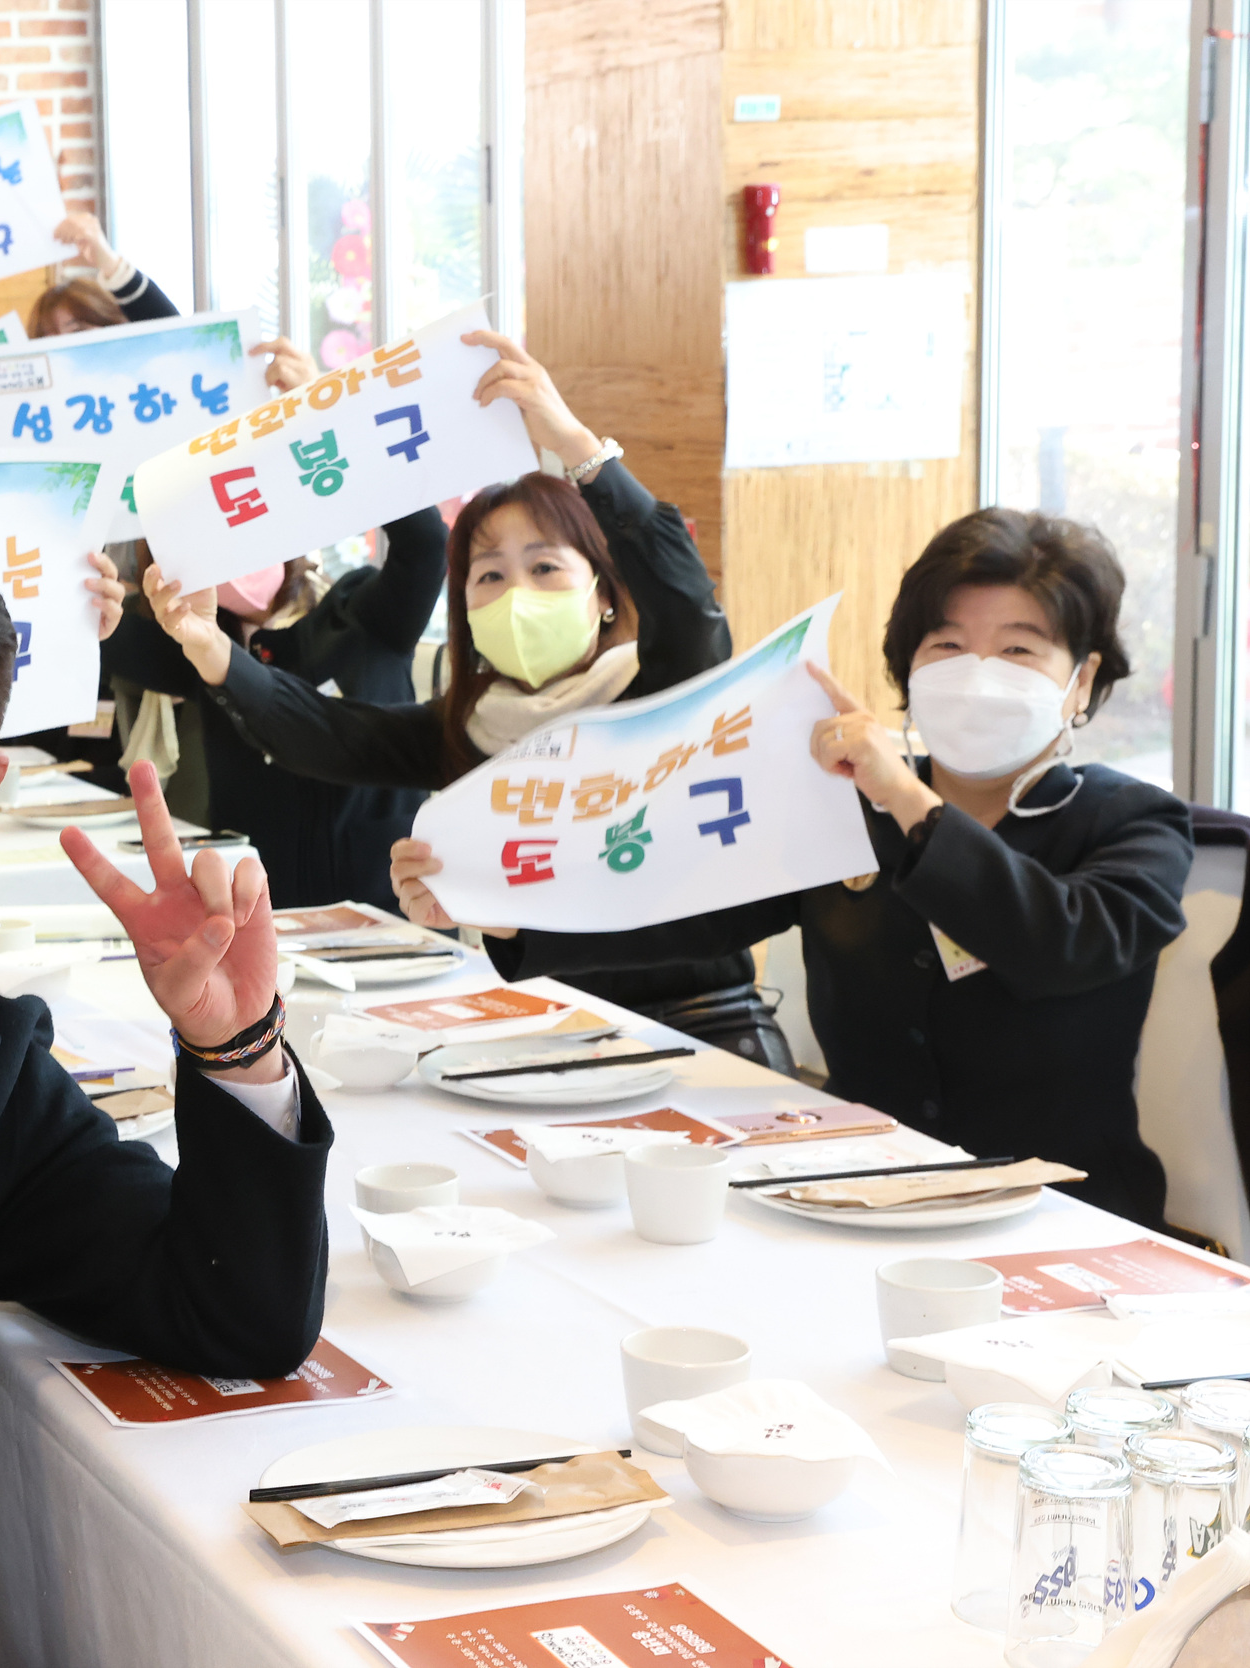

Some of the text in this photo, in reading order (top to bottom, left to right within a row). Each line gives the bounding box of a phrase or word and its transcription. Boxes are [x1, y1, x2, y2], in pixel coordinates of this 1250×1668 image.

[12, 373, 230, 443] 성장하는
[209, 403, 431, 528] 도봉구
[490, 704, 752, 827] 변화하는
[501, 777, 751, 887] 도봉구
